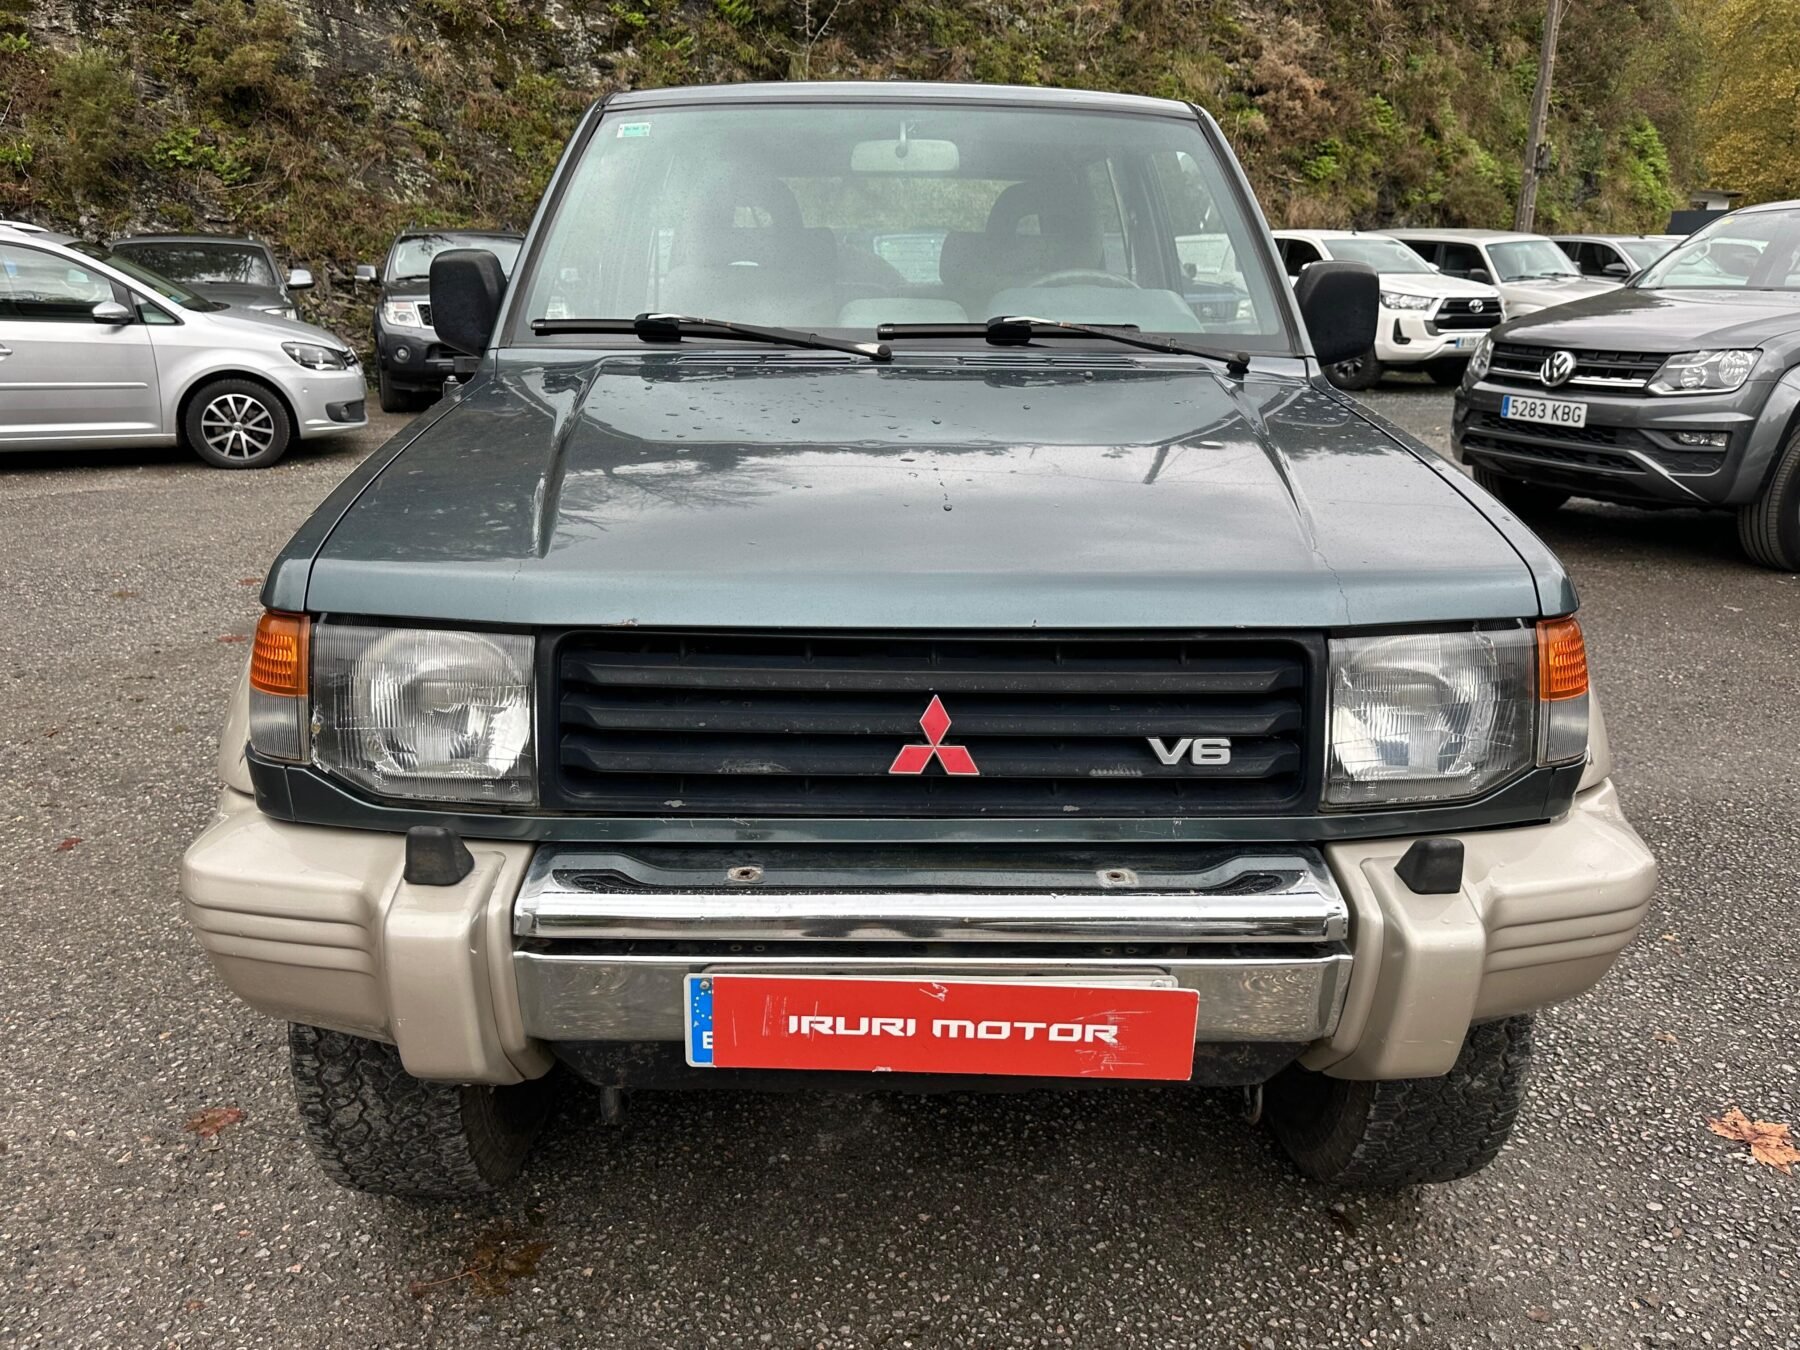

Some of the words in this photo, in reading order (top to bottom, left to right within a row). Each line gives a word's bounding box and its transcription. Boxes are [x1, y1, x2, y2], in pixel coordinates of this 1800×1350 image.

[1511, 399, 1546, 419] 5283
[1551, 404, 1582, 423] KBG
[1147, 737, 1232, 765] V6
[788, 1015, 917, 1037] IRURI
[931, 1018, 1119, 1045] MOTOR
